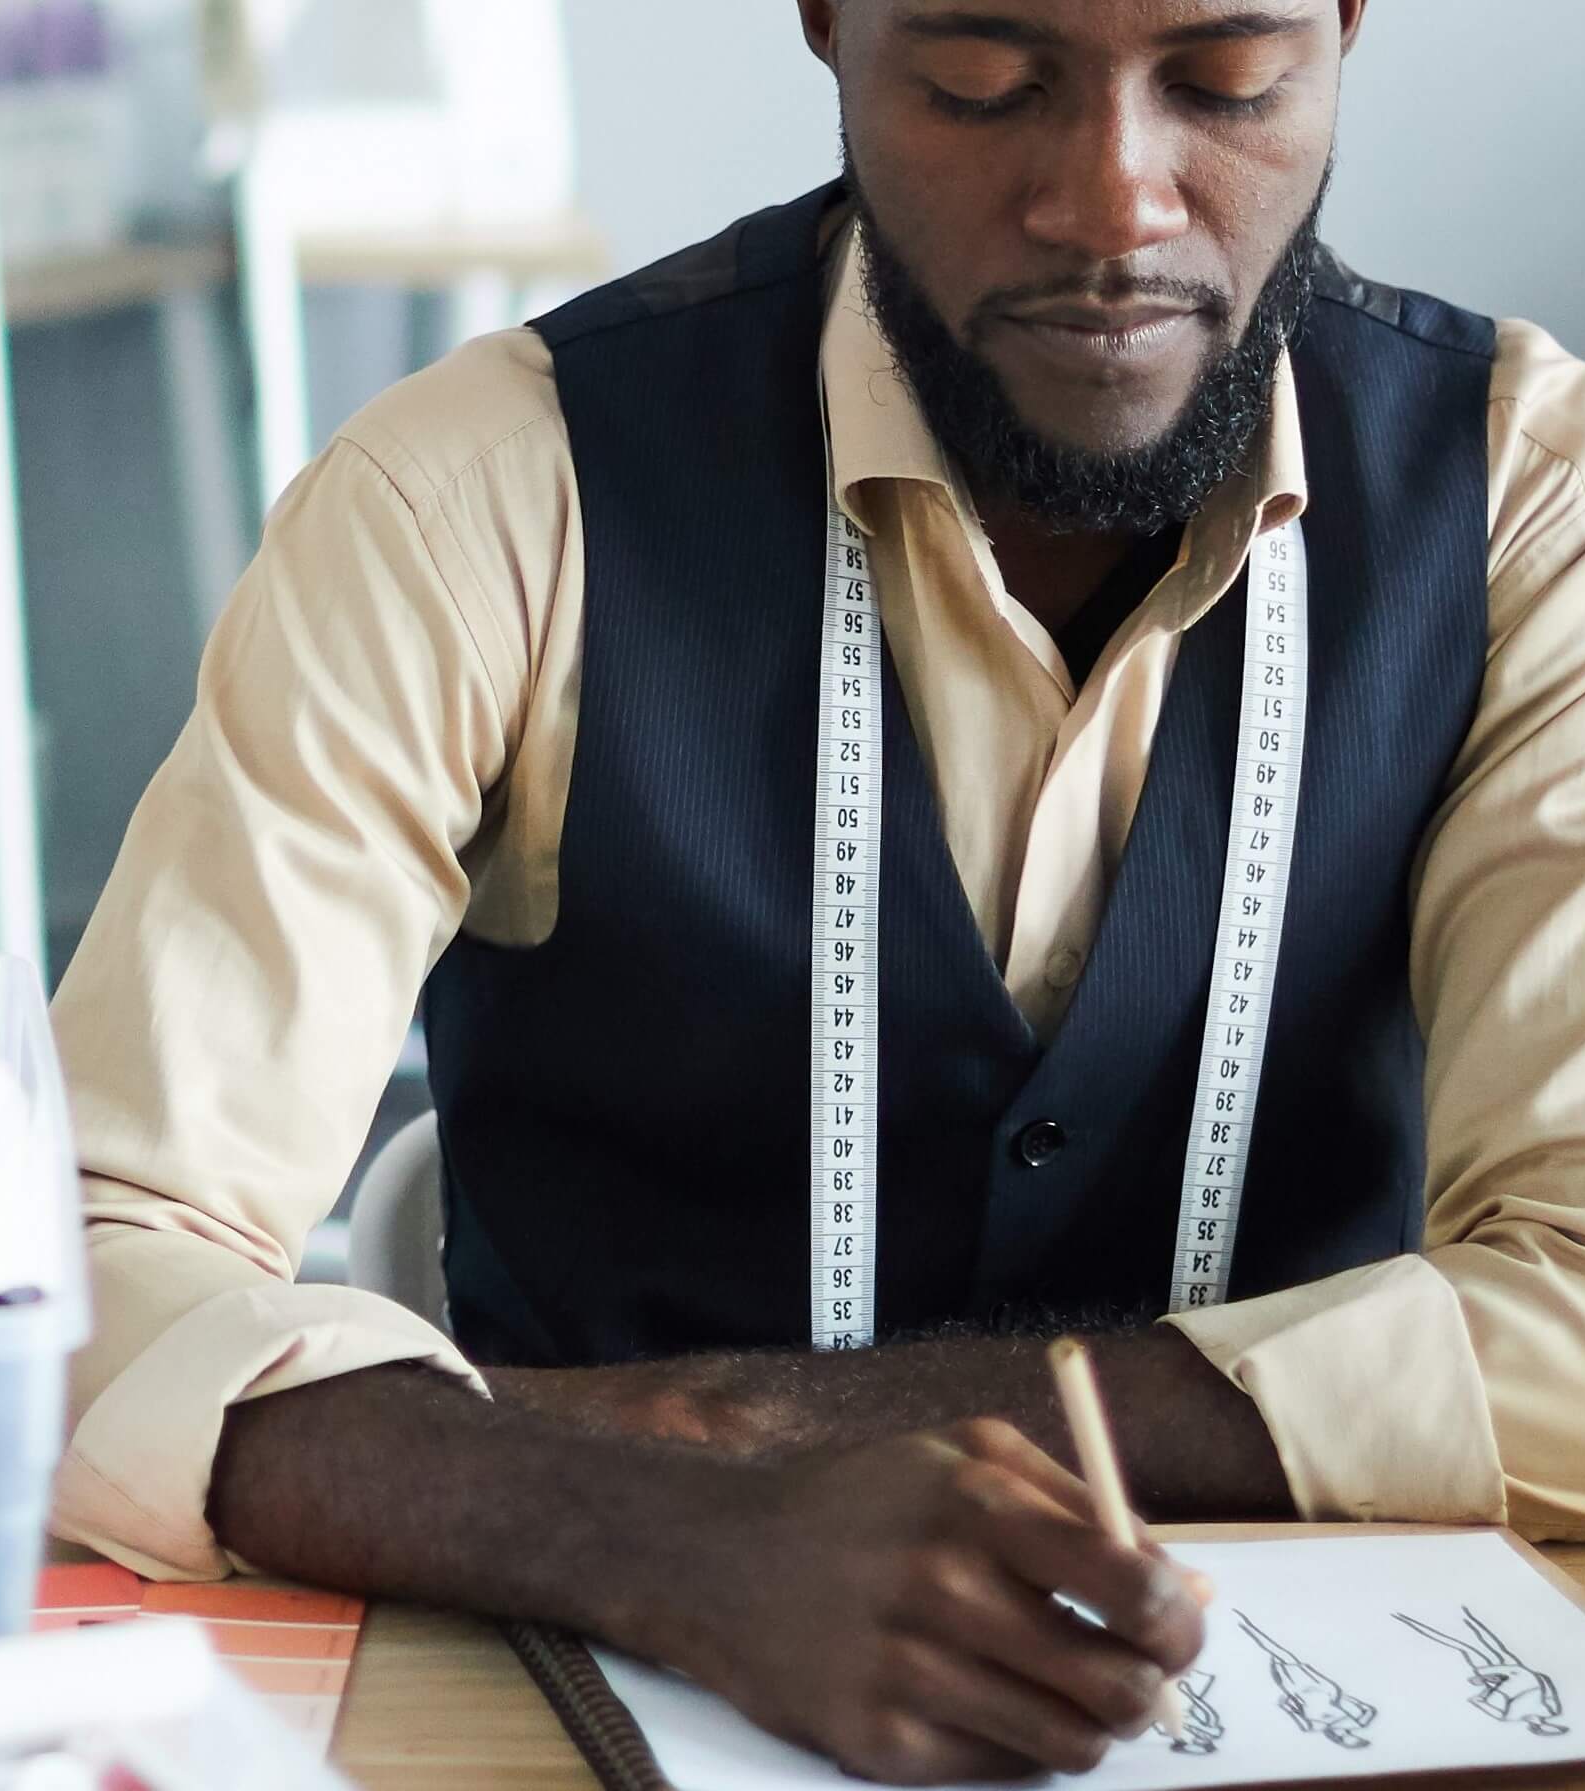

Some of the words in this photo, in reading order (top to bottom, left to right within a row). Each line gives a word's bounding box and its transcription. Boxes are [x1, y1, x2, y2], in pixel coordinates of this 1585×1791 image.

[846, 548, 862, 570] 58
[1270, 541, 1286, 560] 56
[846, 581, 863, 602] 57
[1268, 572, 1285, 592] 55
[1267, 604, 1284, 623] 54
[845, 613, 863, 634] 56
[1266, 634, 1284, 654] 53
[843, 646, 861, 666] 55
[1265, 666, 1283, 686] 52
[842, 678, 860, 697] 54
[1264, 699, 1282, 718] 51
[842, 710, 861, 729] 53
[1260, 731, 1279, 751] 50
[840, 742, 860, 761] 52
[1257, 764, 1276, 784] 49
[841, 776, 859, 795] 51
[1254, 797, 1273, 816] 48
[838, 808, 858, 828] 50
[1250, 831, 1269, 850] 47
[837, 841, 857, 861] 49
[1247, 863, 1266, 882] 46
[836, 874, 855, 895] 48
[1243, 896, 1261, 915] 45
[835, 909, 855, 928] 47
[1238, 929, 1257, 948] 44
[835, 942, 854, 961] 46
[1234, 962, 1253, 981] 43
[835, 975, 854, 994] 45
[1229, 994, 1249, 1013] 42
[834, 1008, 854, 1027] 44
[1227, 1027, 1244, 1046] 41
[834, 1040, 854, 1060] 43
[1221, 1059, 1240, 1078] 40
[834, 1074, 854, 1092] 42
[1216, 1092, 1236, 1112] 39
[836, 1106, 853, 1125] 41
[1211, 1123, 1231, 1144] 38
[834, 1139, 853, 1158] 40
[1206, 1156, 1226, 1176] 37
[834, 1171, 853, 1191] 39
[1202, 1188, 1221, 1208] 36
[834, 1203, 853, 1223] 38
[1197, 1220, 1216, 1240] 35
[834, 1236, 853, 1256] 37
[1193, 1253, 1212, 1273] 34
[833, 1269, 852, 1288] 36
[1189, 1286, 1208, 1305] 33
[833, 1301, 852, 1320] 35
